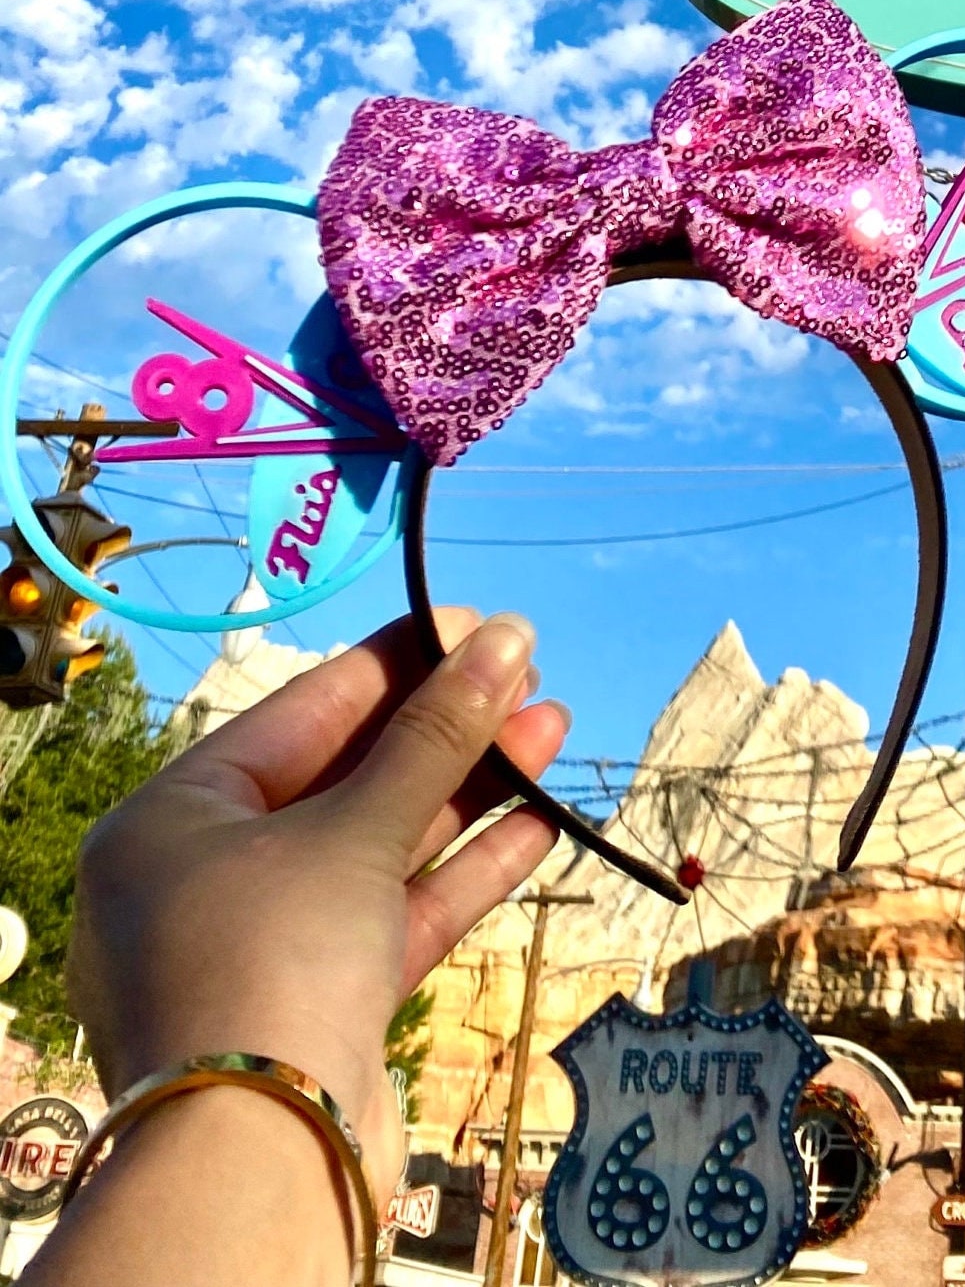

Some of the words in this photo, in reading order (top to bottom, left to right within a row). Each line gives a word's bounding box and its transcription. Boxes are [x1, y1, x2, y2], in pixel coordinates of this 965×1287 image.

[619, 1048, 764, 1095] ROUTE
[0, 1140, 80, 1176] IRE
[587, 1112, 768, 1253] 66
